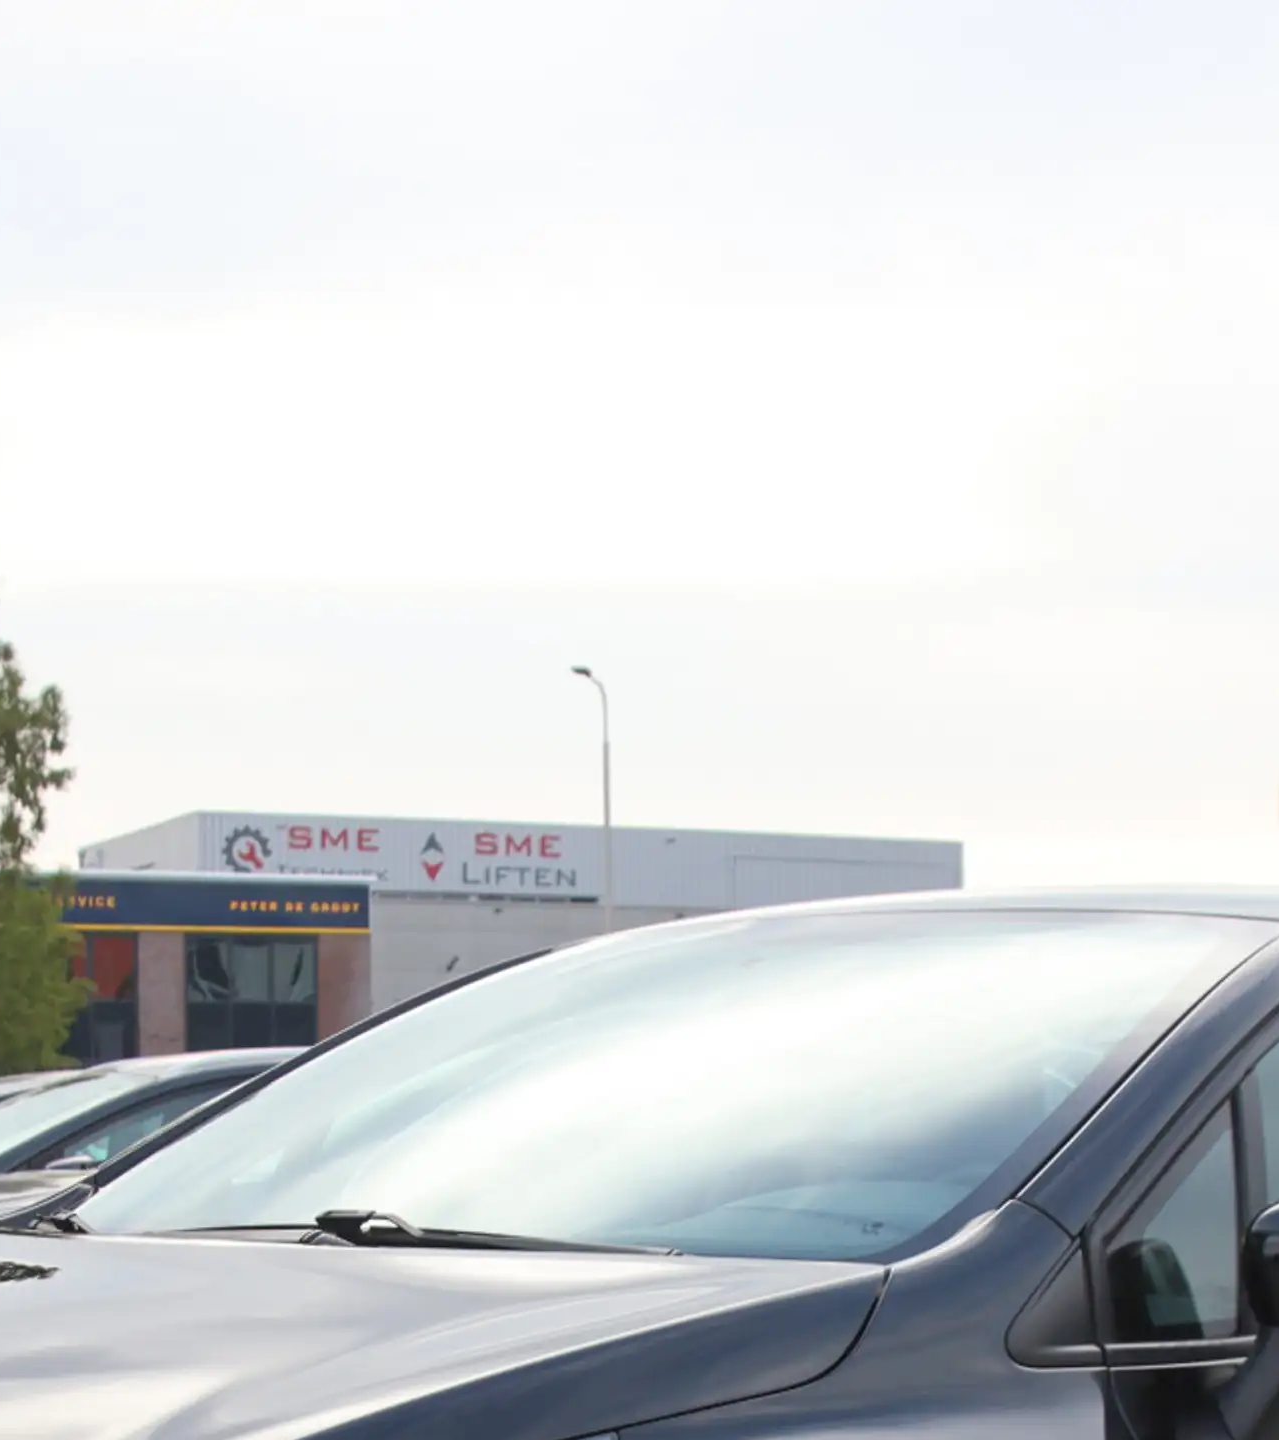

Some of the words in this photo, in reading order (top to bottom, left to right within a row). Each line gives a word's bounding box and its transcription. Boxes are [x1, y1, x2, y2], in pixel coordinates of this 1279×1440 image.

[287, 825, 380, 852] SME
[474, 832, 562, 858] SME
[461, 862, 576, 888] LIFTEN
